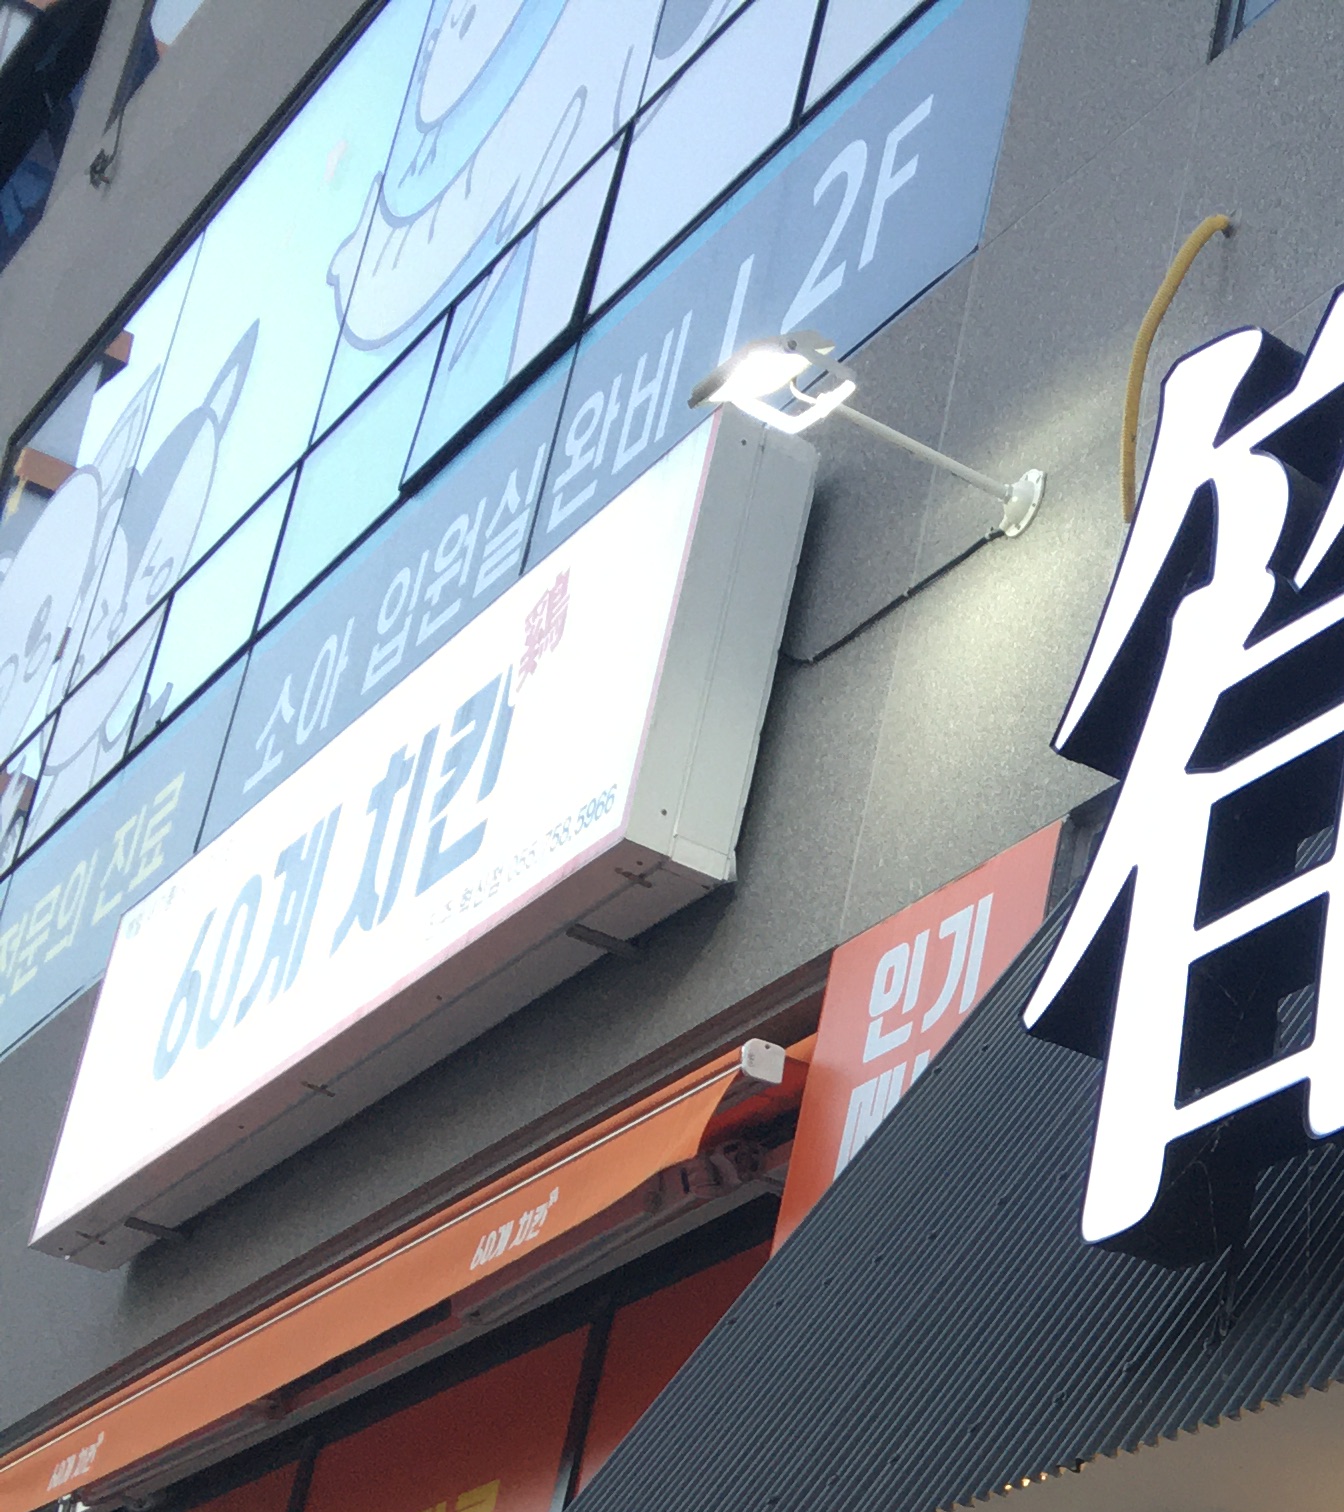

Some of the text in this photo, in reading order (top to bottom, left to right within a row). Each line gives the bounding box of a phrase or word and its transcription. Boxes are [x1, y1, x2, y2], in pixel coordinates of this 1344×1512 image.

[92, 771, 186, 926] 진료
[243, 616, 355, 794] 소아
[361, 442, 548, 695] 입원실
[546, 309, 694, 535] 완비
[780, 93, 934, 336] 2F
[153, 664, 516, 1081] 60계 치킨
[863, 893, 994, 1063] 인기
